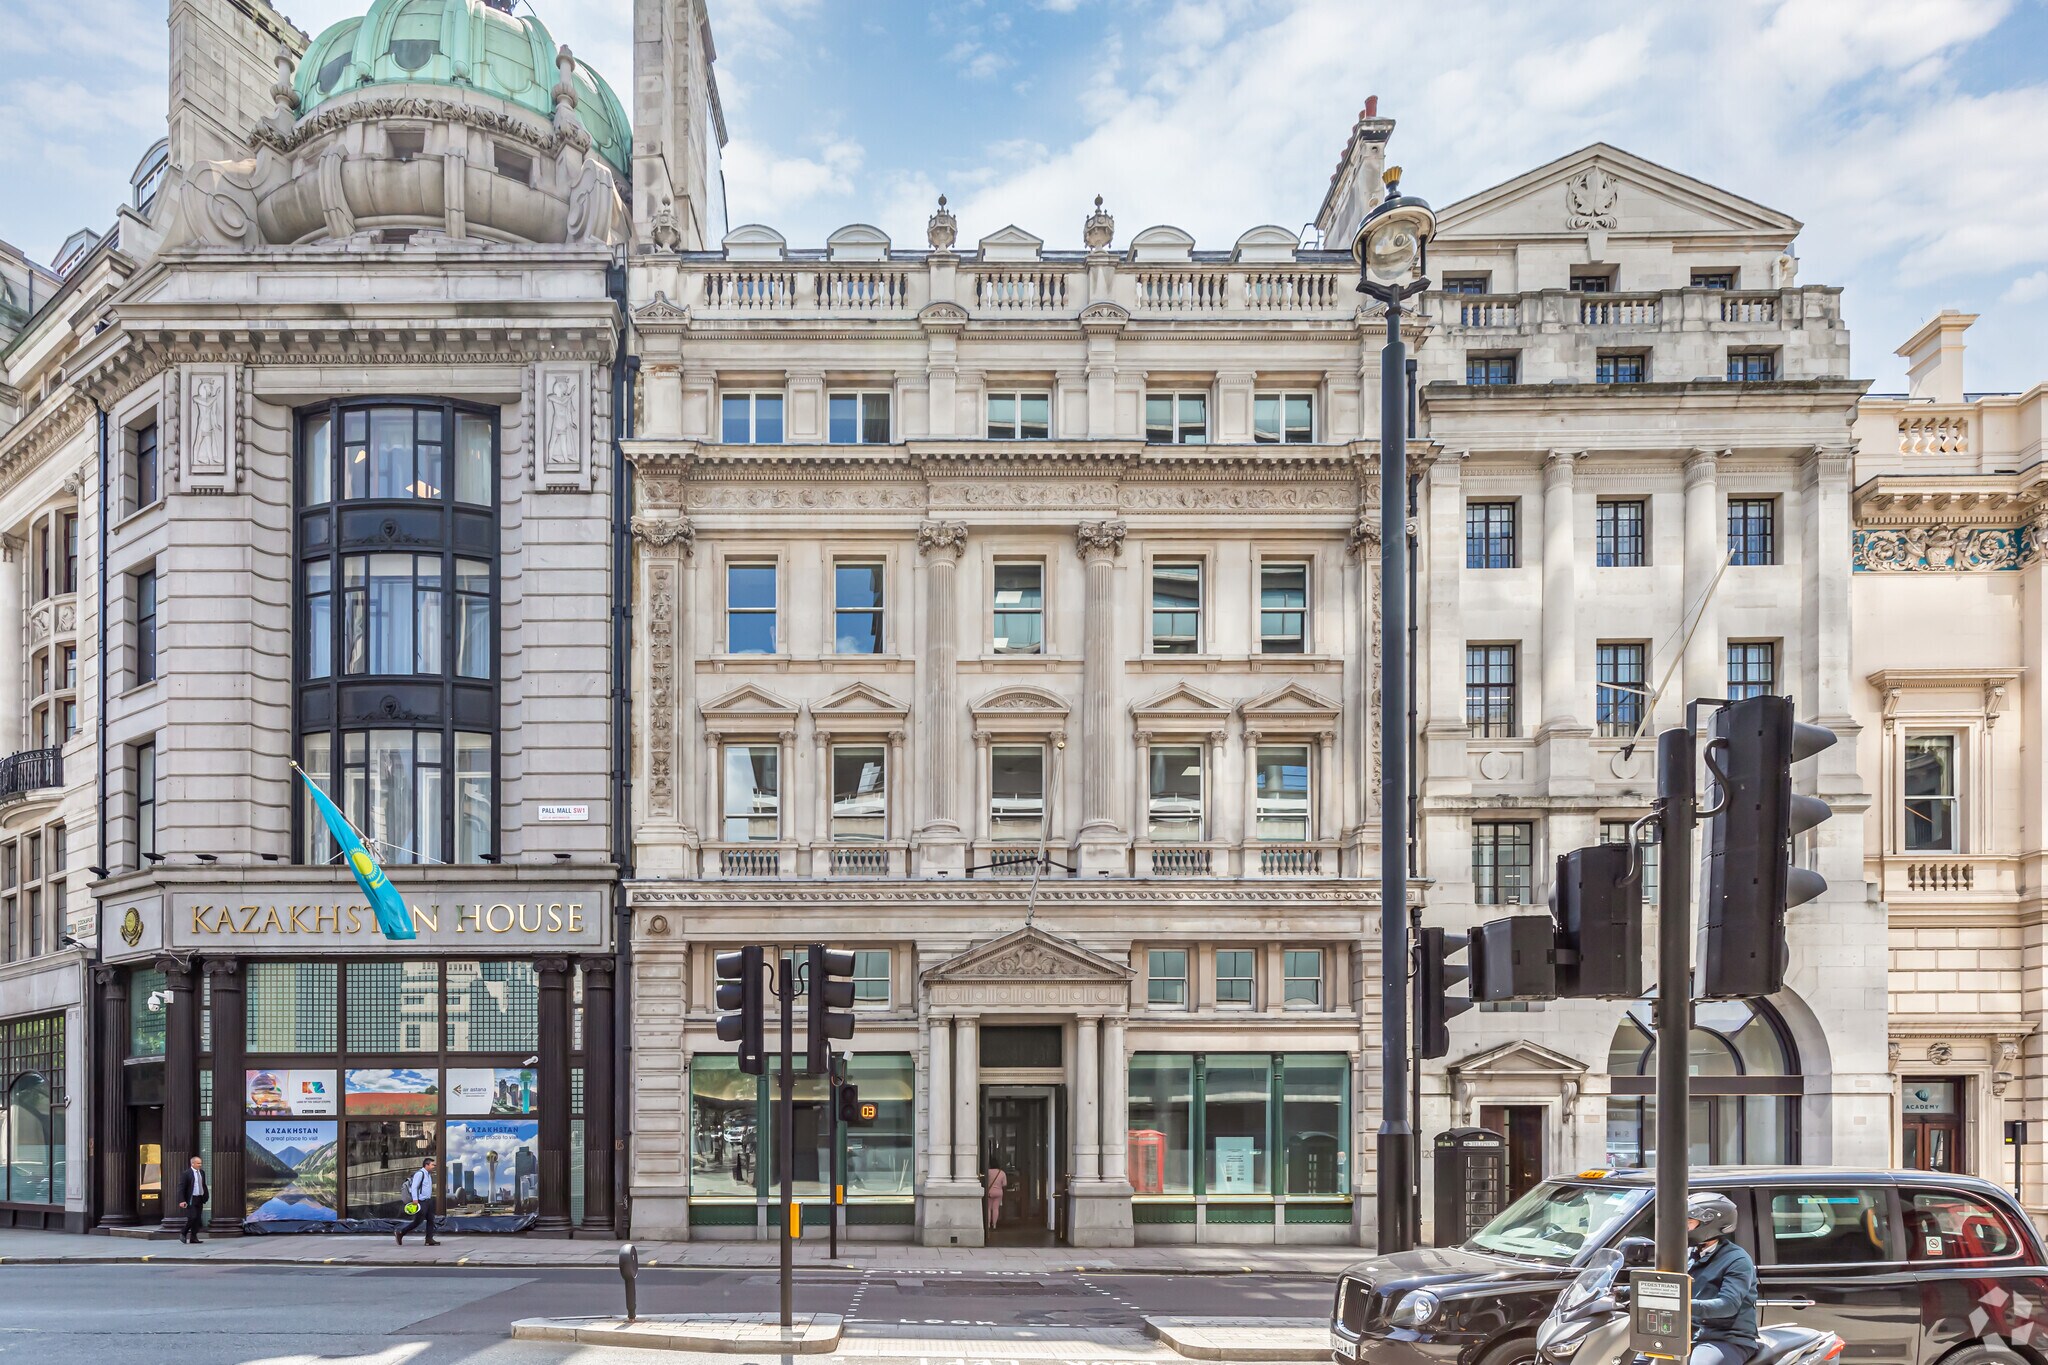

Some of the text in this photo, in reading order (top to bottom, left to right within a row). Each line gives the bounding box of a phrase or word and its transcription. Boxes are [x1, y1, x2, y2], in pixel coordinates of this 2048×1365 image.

[191, 903, 583, 933] KAZAKHSTN HOUSE
[862, 1106, 875, 1117] 03
[1640, 1282, 1679, 1290] PEDESTRIANS
